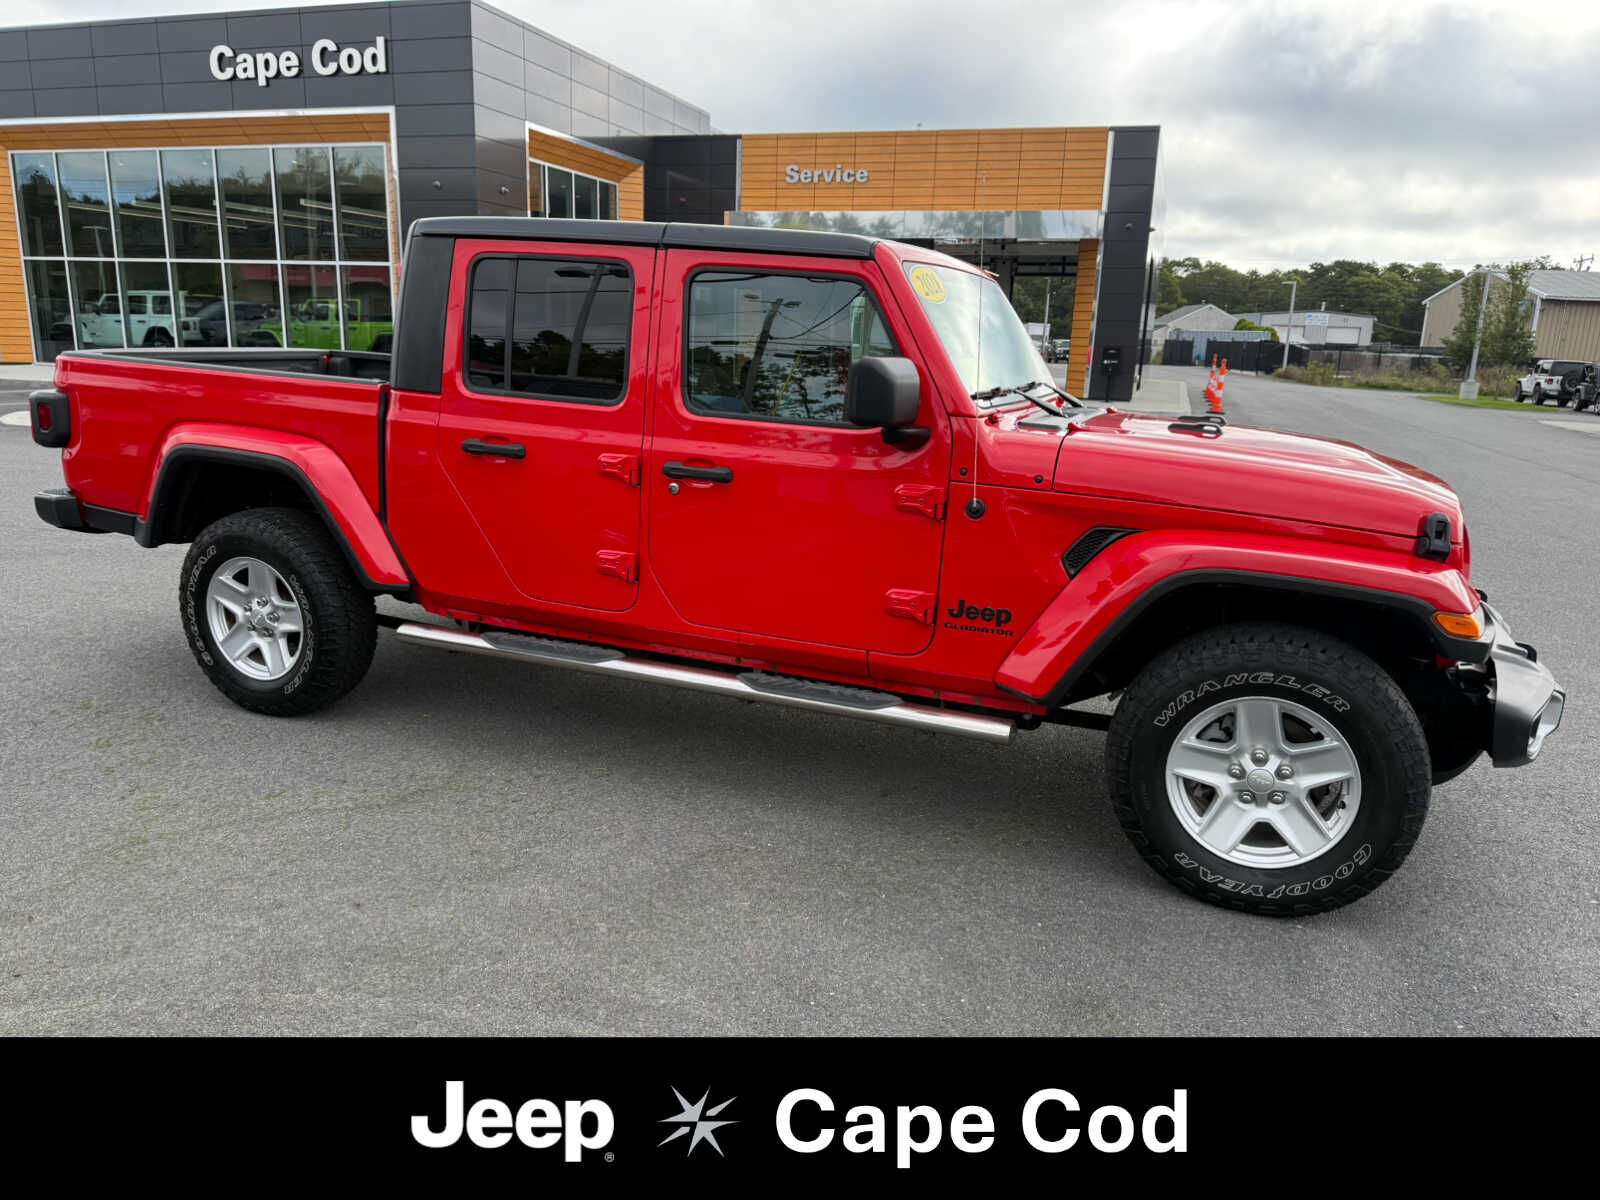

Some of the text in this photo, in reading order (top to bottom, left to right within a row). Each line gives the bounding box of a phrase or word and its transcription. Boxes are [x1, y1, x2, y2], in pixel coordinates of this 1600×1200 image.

[209, 36, 388, 87] Cape Cod
[785, 164, 870, 184] Service
[944, 623, 1015, 637] GLADIATOR
[947, 599, 1012, 627] Jeep
[1153, 672, 1351, 727] WRANGLER
[1174, 843, 1373, 899] GOODYEAR
